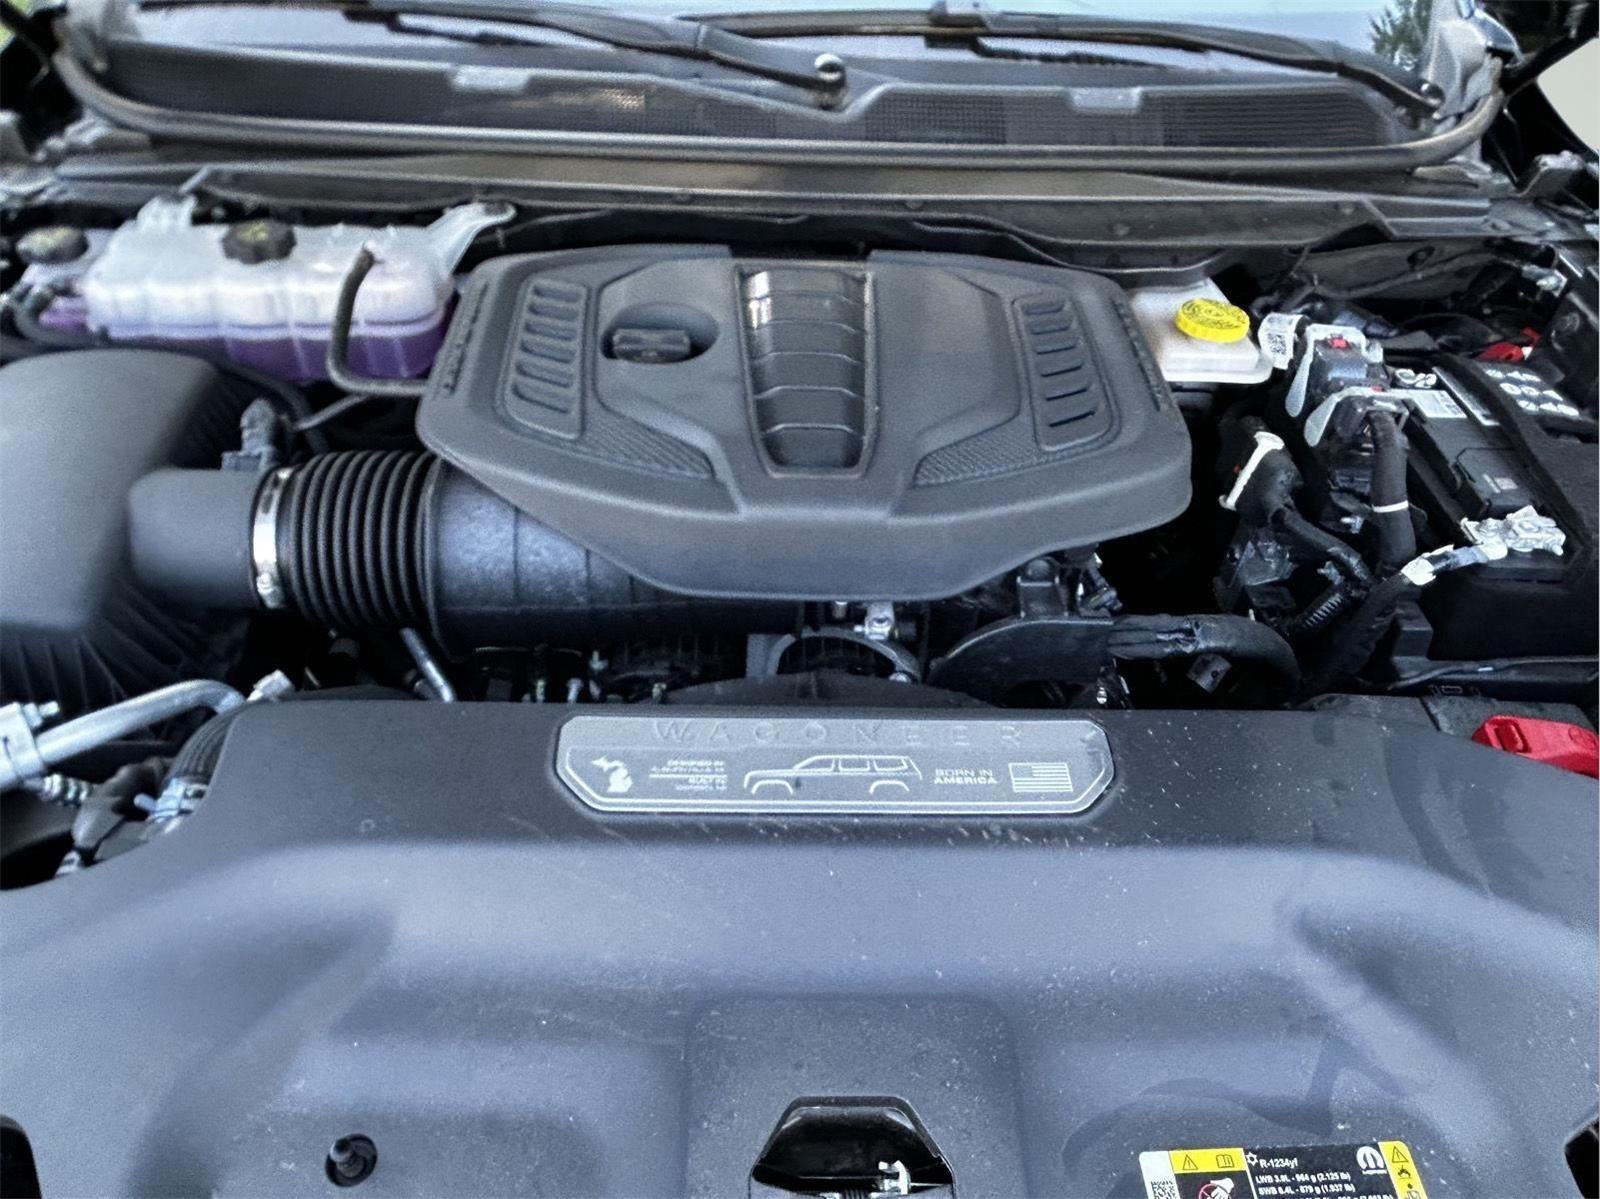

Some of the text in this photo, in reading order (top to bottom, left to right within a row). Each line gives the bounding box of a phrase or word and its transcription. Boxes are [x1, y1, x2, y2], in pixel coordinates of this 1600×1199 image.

[654, 719, 1023, 748] WAGONEER
[935, 768, 993, 777] BORN IN
[934, 776, 998, 785] AMERICA
[1260, 1158, 1298, 1169] R-1234yf
[1255, 1175, 1274, 1184] LWB
